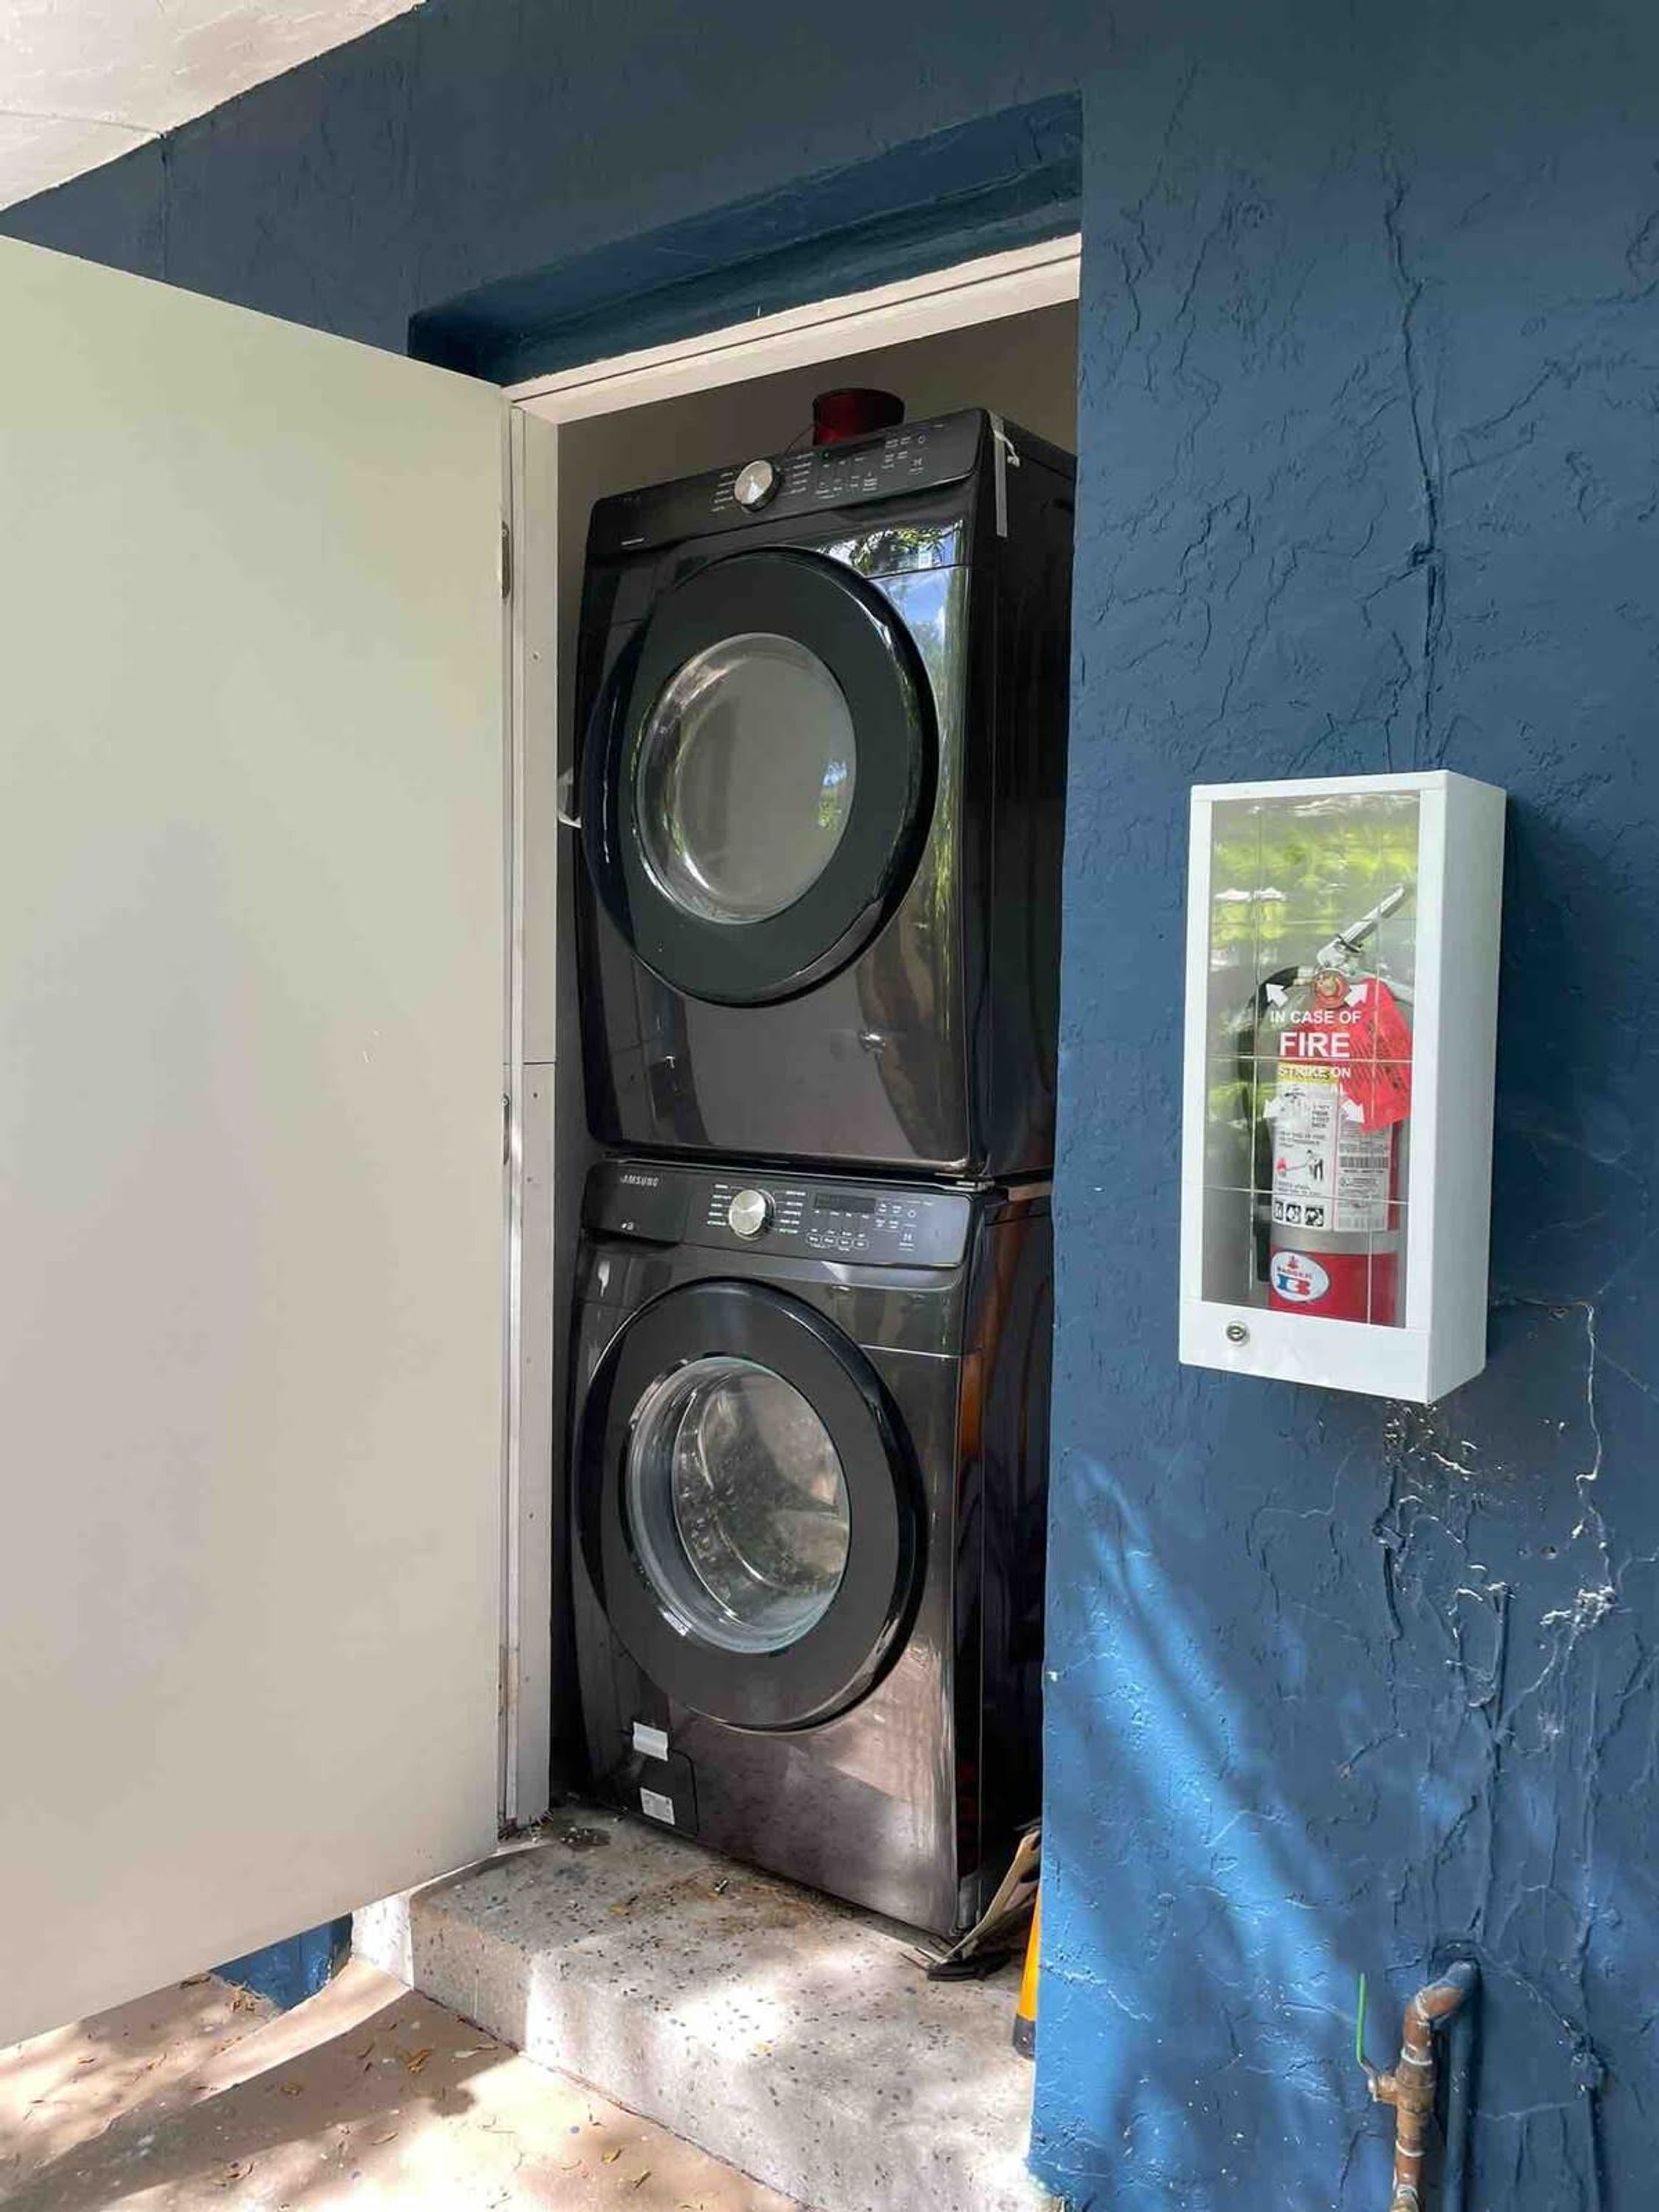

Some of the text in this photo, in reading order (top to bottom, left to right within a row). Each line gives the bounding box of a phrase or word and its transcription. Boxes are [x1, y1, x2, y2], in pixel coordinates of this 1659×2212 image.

[1270, 1010, 1362, 1023] IN CASE OF
[1279, 1032, 1351, 1057] FIRE
[1279, 1066, 1351, 1079] STRIKE ON
